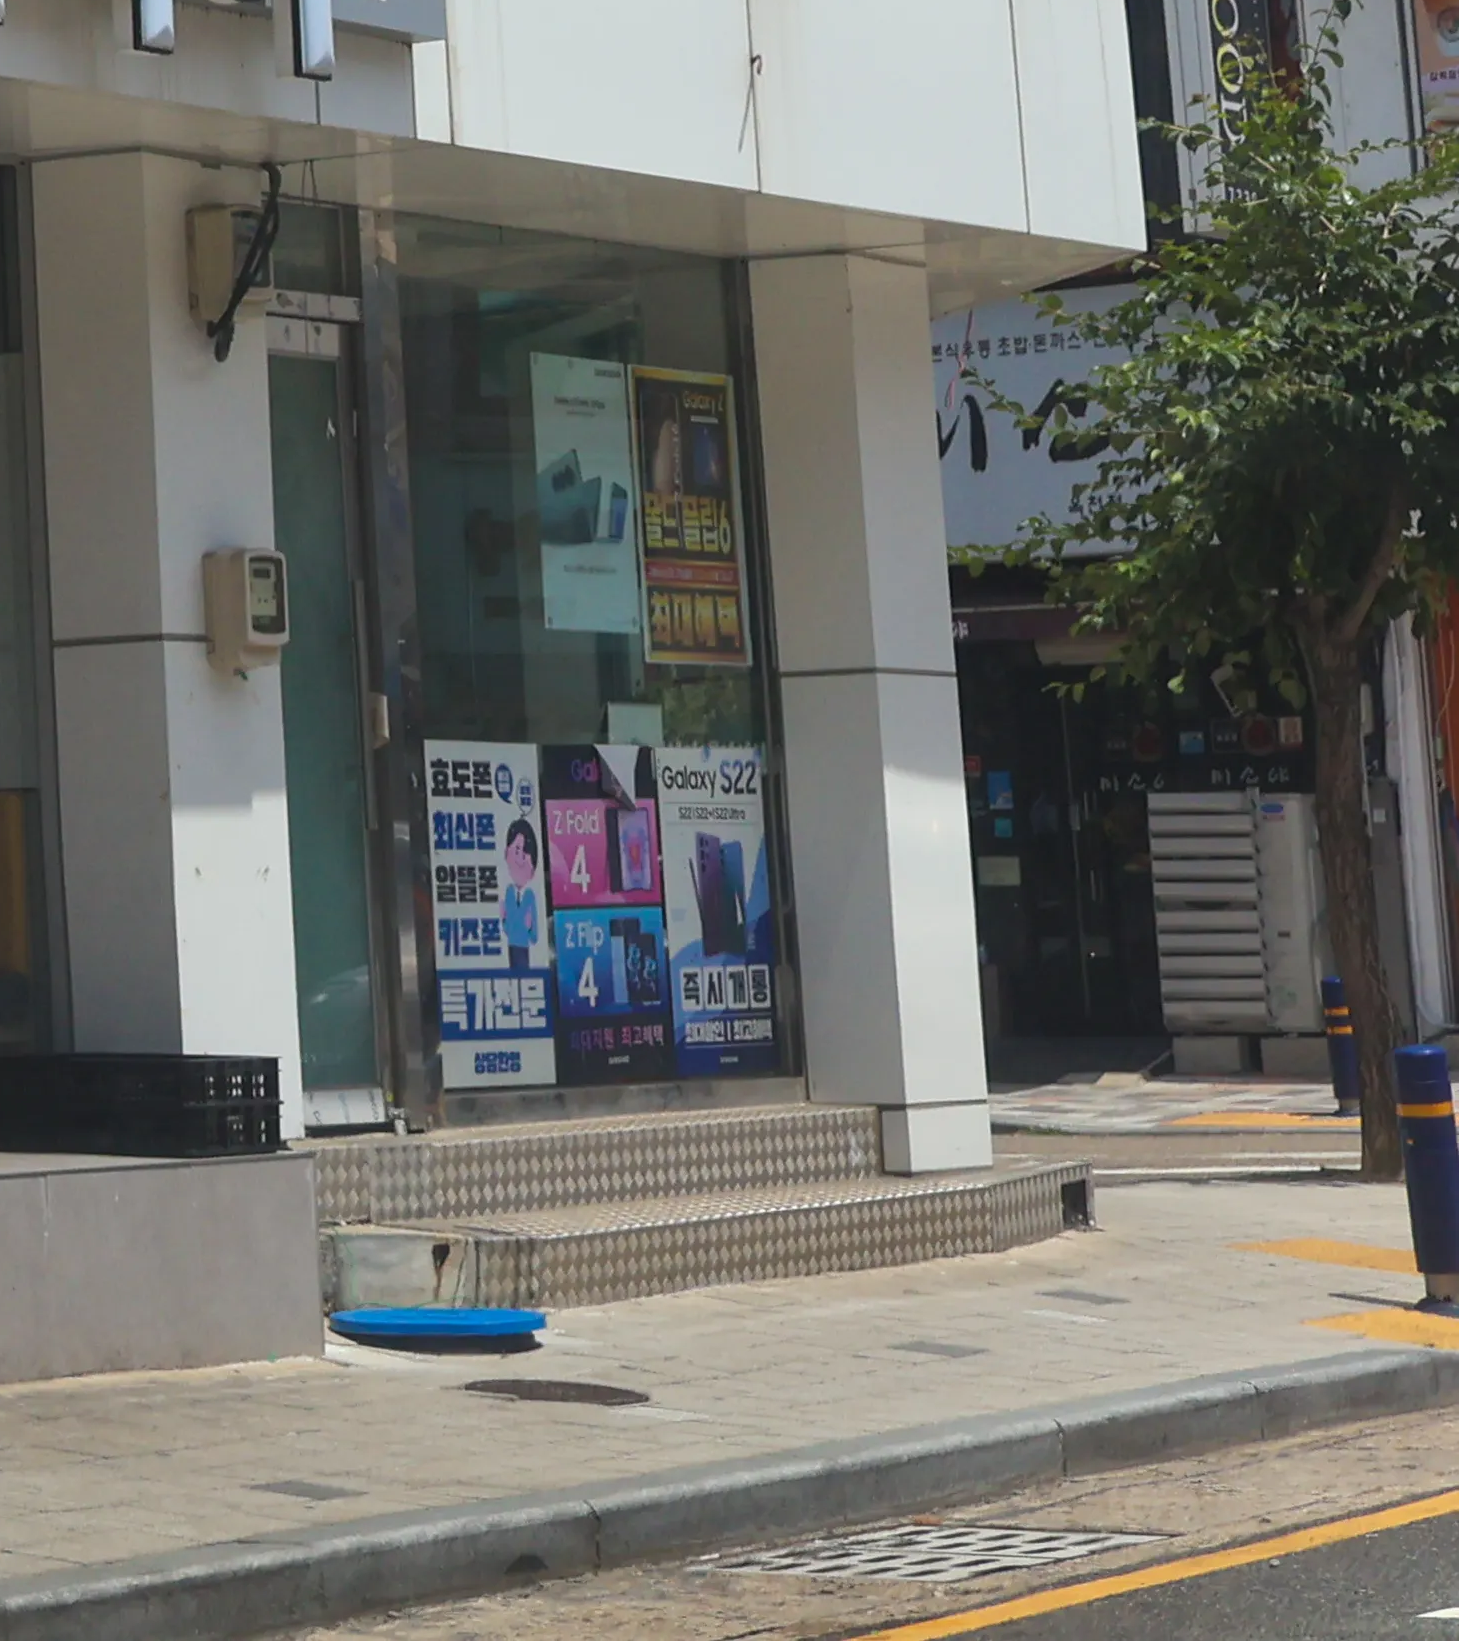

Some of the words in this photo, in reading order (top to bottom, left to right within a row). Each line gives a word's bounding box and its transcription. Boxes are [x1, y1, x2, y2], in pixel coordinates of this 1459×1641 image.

[429, 757, 493, 800] 효도폰
[571, 759, 601, 782] Gal
[662, 764, 717, 799] Galaxy
[720, 759, 757, 795] S22
[432, 809, 497, 851] 최신폰
[552, 809, 563, 835] Z
[566, 808, 601, 836] Fold
[434, 864, 499, 904] 알뜰폰
[570, 844, 591, 894] 4
[437, 917, 502, 957] 키즈폰
[564, 922, 575, 949] Z
[577, 919, 604, 956] Flip
[577, 956, 599, 1008] 4
[683, 969, 768, 1006] 즉시개통
[439, 976, 548, 1032] 특가전문
